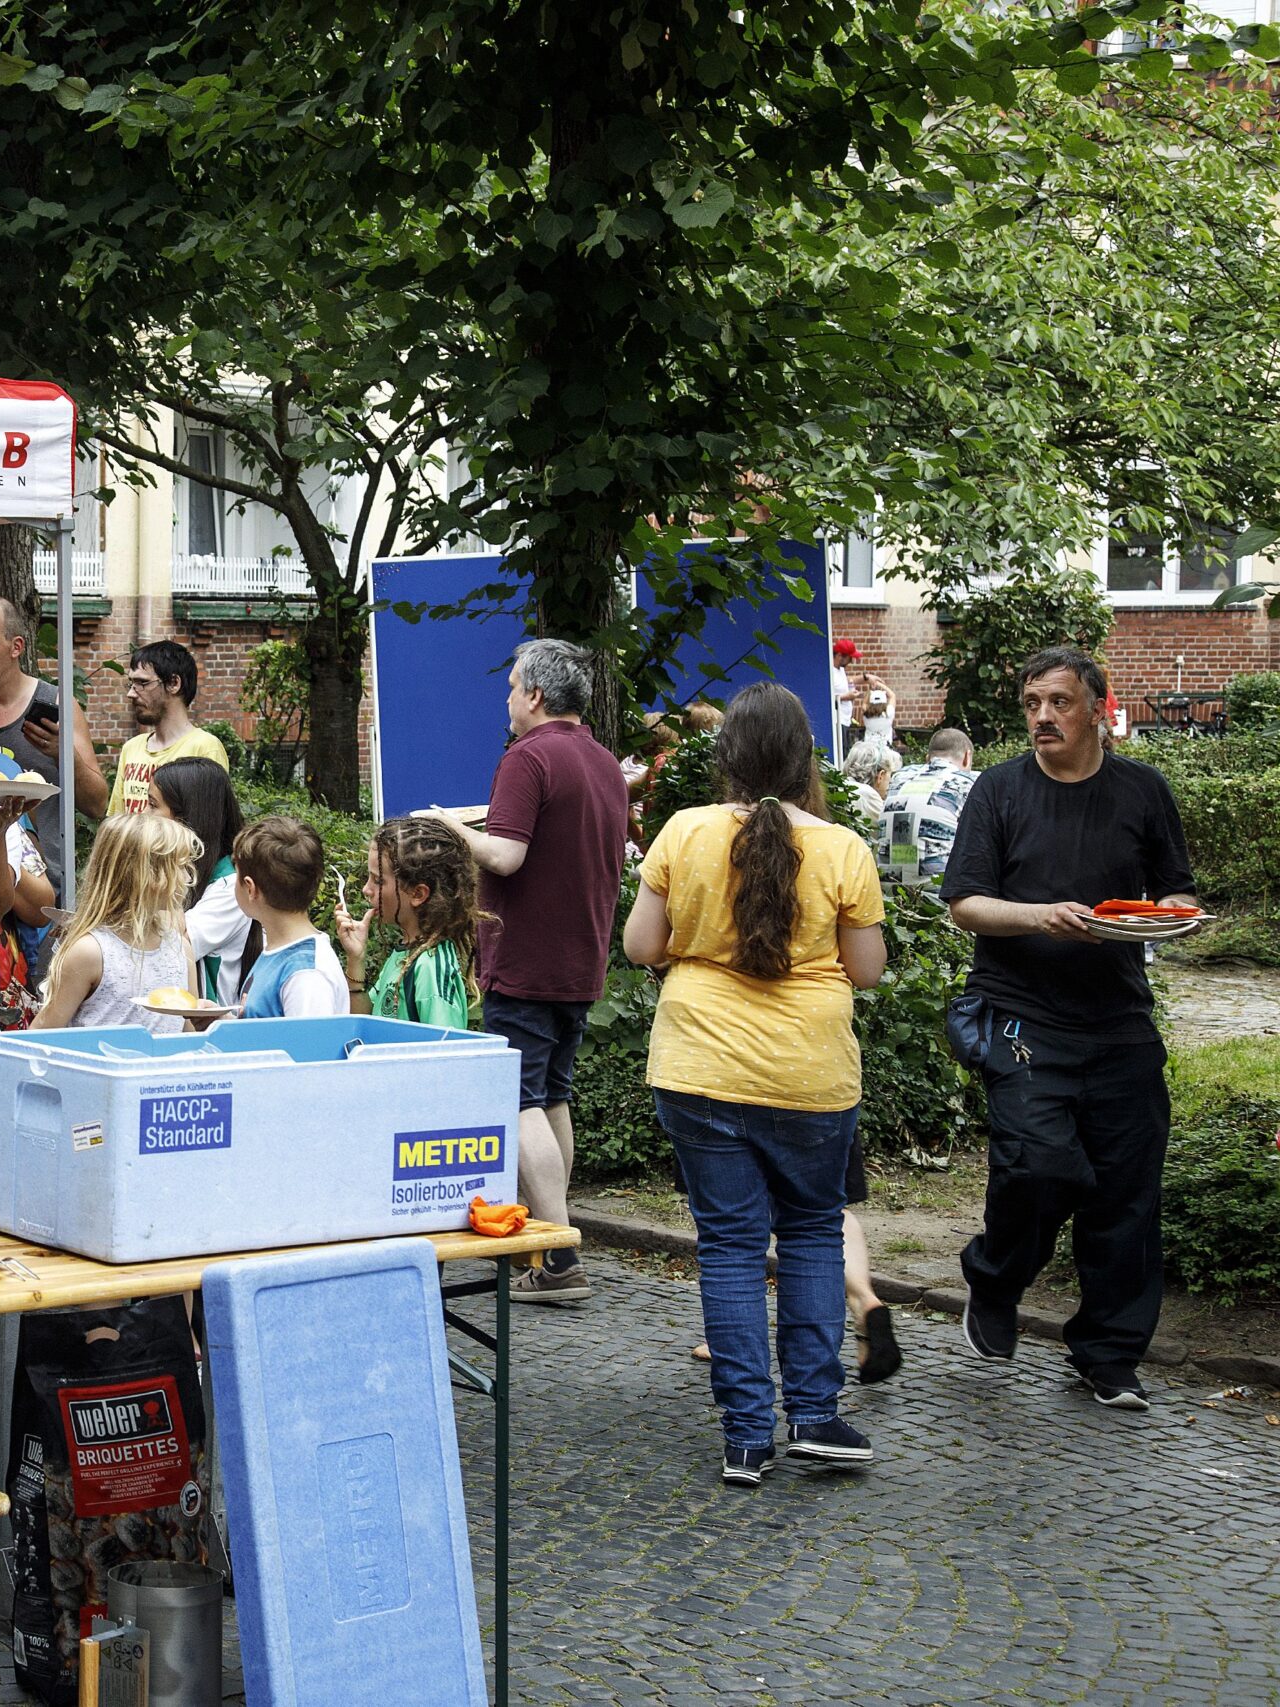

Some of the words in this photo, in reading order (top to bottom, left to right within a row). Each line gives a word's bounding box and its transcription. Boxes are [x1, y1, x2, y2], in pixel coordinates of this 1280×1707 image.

[140, 1084, 175, 1095] Unterstützt
[176, 1084, 186, 1092] die
[187, 1082, 216, 1092] Kühlkette
[217, 1081, 233, 1089] nach
[152, 1098, 219, 1123] HACCP-
[145, 1121, 224, 1149] Standard
[399, 1136, 499, 1168] METRO
[392, 1181, 464, 1203] Isolierbox
[391, 1207, 409, 1216] Sicher
[410, 1204, 432, 1217] gekühlt
[437, 1202, 467, 1214] hygienisch
[75, 1400, 141, 1438] weber
[76, 1437, 179, 1466] BRIQUETTES
